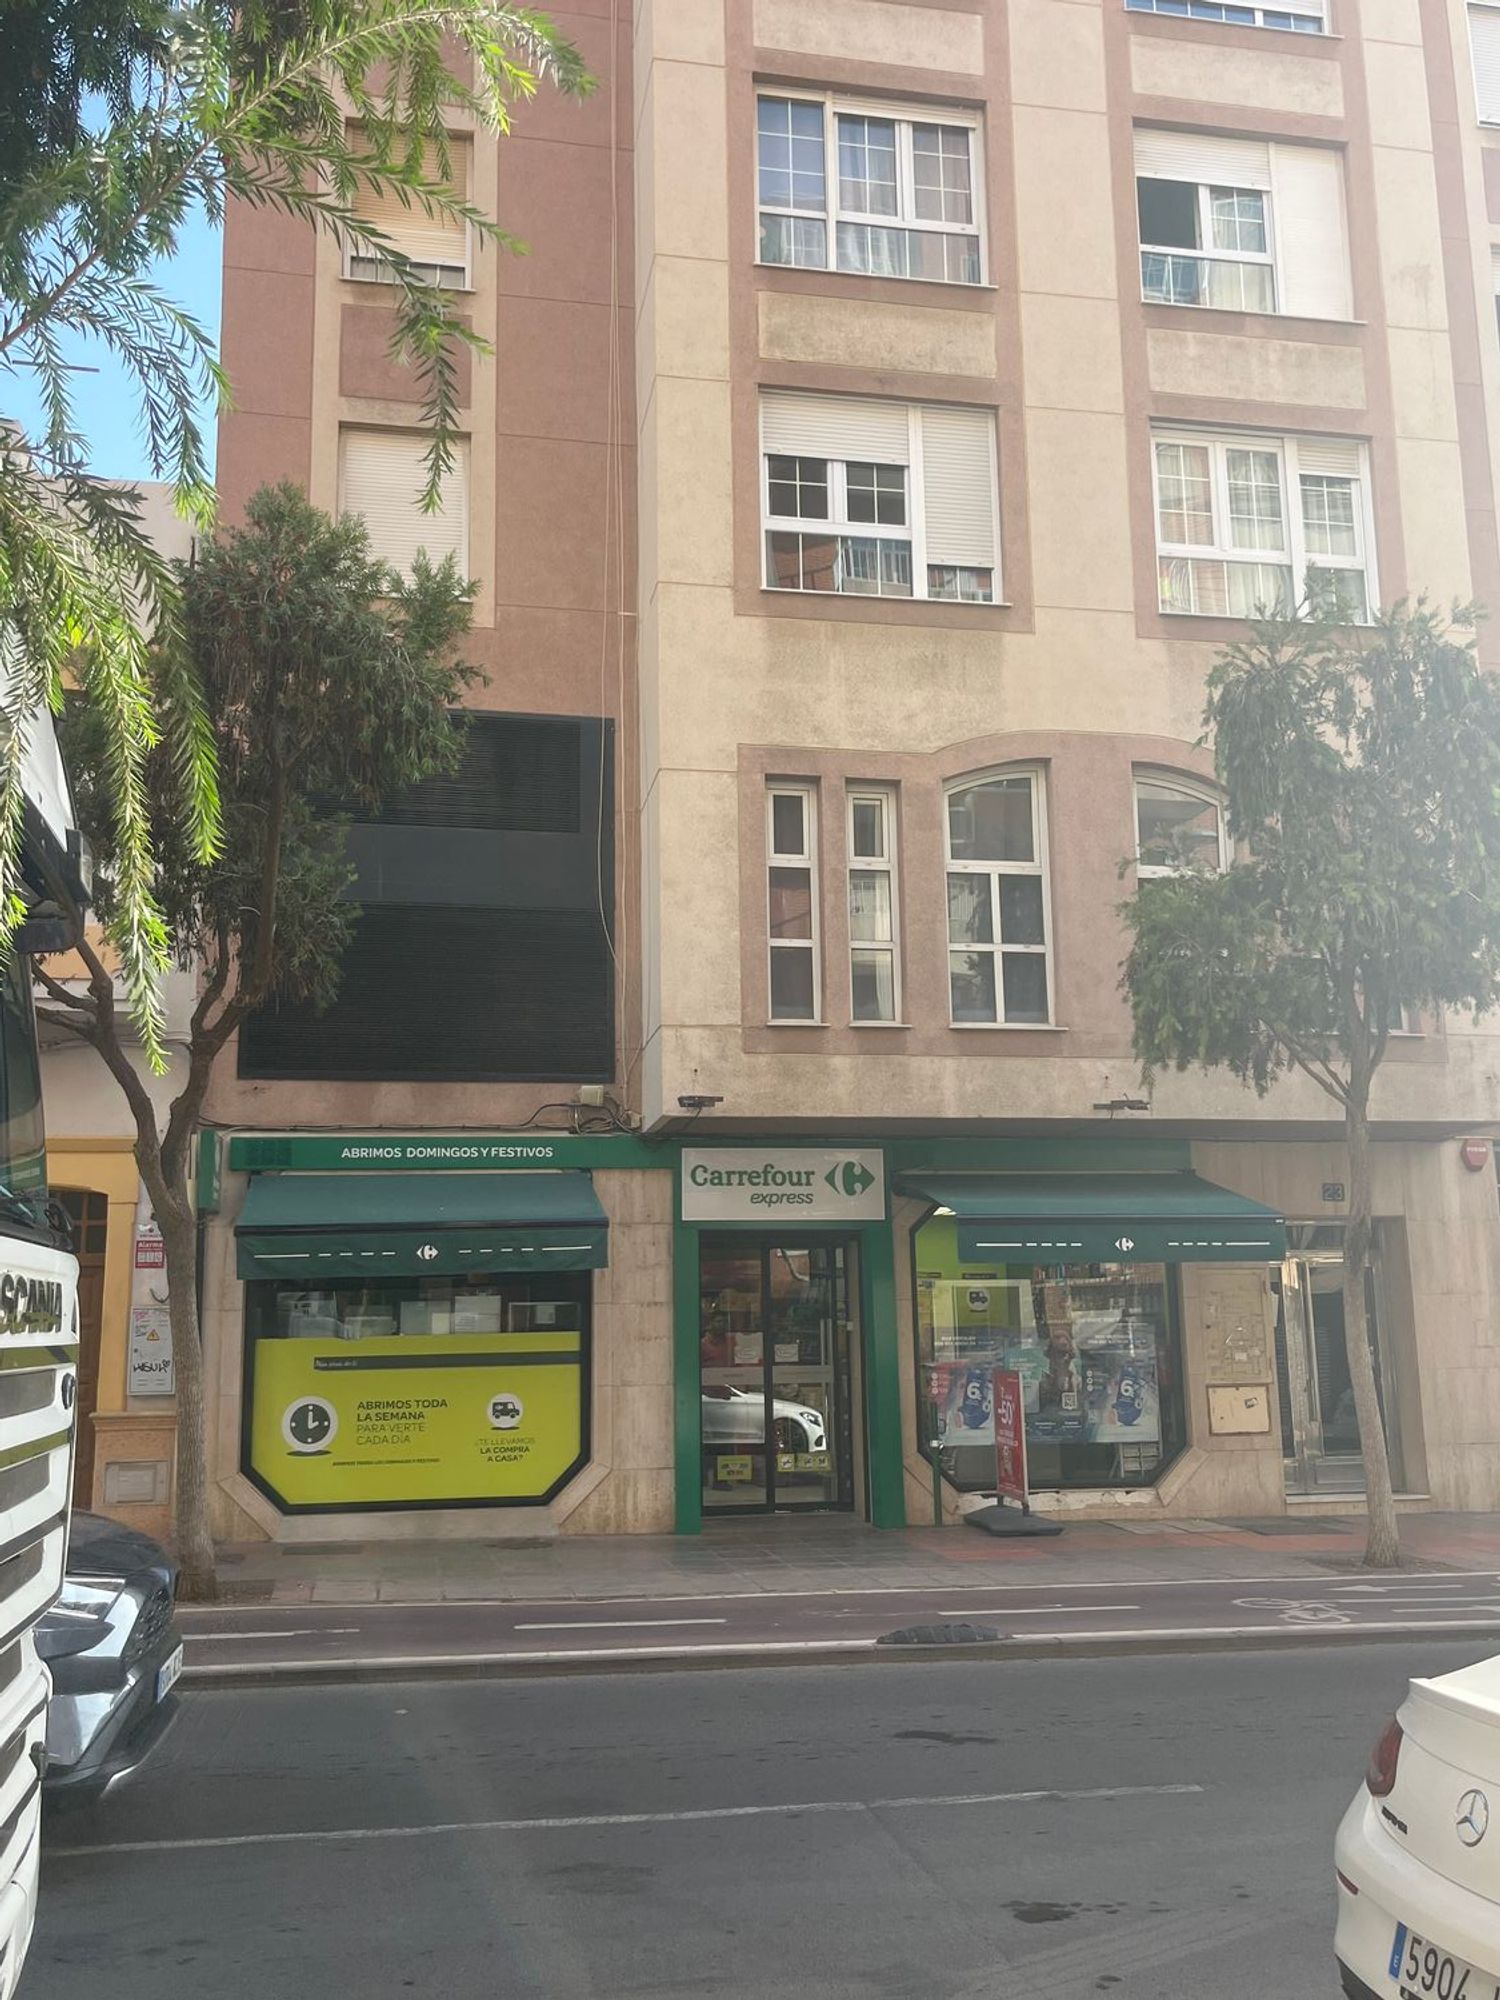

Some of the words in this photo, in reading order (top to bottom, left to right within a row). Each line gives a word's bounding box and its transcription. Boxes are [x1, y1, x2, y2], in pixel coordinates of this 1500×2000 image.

[341, 1147, 402, 1159] ABRIMOS
[406, 1147, 478, 1158] DOMINGOS
[480, 1147, 489, 1158] Y
[491, 1146, 554, 1158] FESTIVOS
[690, 1163, 815, 1187] Carrefour
[750, 1192, 814, 1208] express
[357, 1400, 412, 1410] ABRIMOS
[414, 1399, 448, 1409] TODA
[357, 1413, 373, 1422] LA
[375, 1411, 425, 1421] SEMANA
[357, 1424, 386, 1433] PARA
[389, 1422, 425, 1432] VERTE
[356, 1435, 389, 1445] CADA
[493, 1446, 530, 1454] COMPRA
[495, 1454, 524, 1463] CASA?
[1405, 1936, 1471, 2000] 5904
